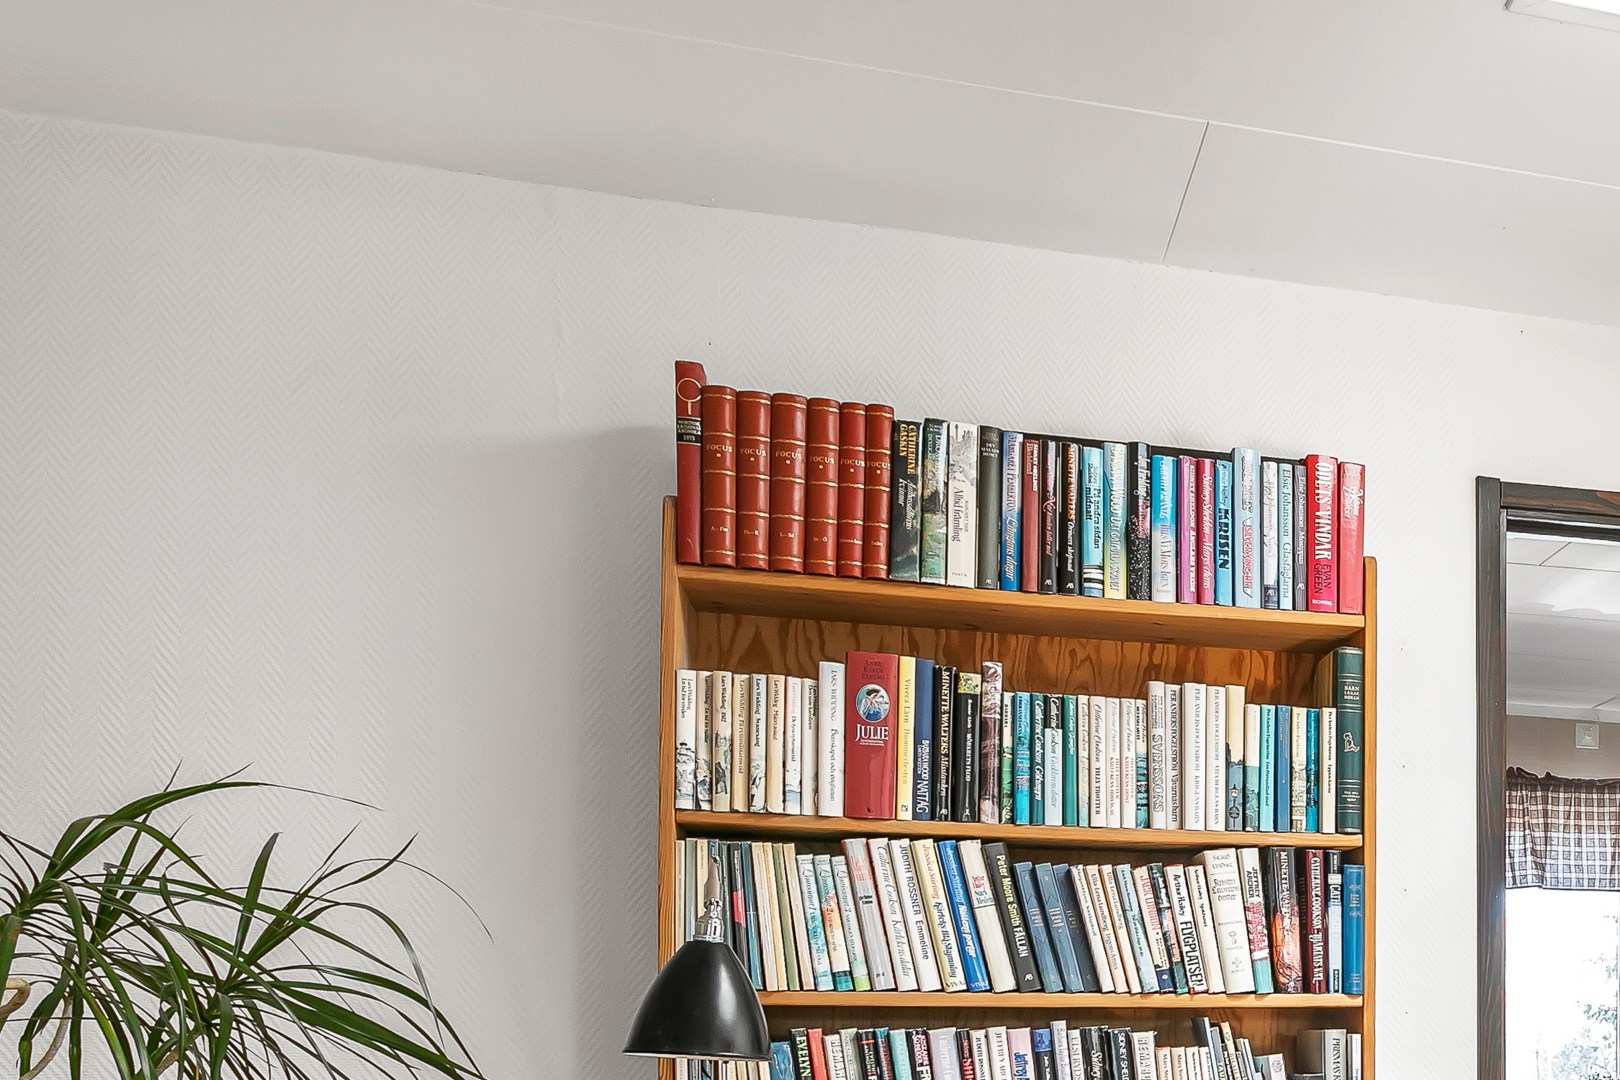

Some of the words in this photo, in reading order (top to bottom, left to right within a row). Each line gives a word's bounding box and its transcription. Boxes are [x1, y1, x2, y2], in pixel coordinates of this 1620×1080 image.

[706, 444, 733, 453] FOCUS
[740, 448, 766, 457] FOCUS
[775, 450, 802, 460] FOCUS
[907, 425, 916, 474] CATHERINE
[840, 459, 866, 468] FOCUS
[867, 460, 891, 470] FOCUS
[1110, 488, 1124, 513] WOOD
[1201, 475, 1212, 500] Sidney
[1202, 501, 1212, 534] Sheldon
[1281, 491, 1291, 537] Johansson
[1219, 508, 1229, 569] KRISEN
[1314, 510, 1333, 560] VINDAR
[1005, 556, 1015, 581] dagar
[1203, 566, 1211, 589] chans
[1314, 563, 1323, 594] GREEN
[1323, 563, 1331, 589] EVAN
[941, 671, 950, 712] MINETTE
[856, 723, 889, 741] JULIE
[941, 714, 950, 754] WALTERS
[1152, 734, 1163, 812] SVENSSONS
[899, 845, 911, 874] JUDITH
[906, 877, 921, 915] ROSSNER
[996, 855, 1008, 877] Peter
[1281, 852, 1290, 890] MINETTE
[1311, 857, 1321, 896] CATHERINE
[1001, 878, 1014, 902] Moore
[1246, 870, 1254, 898] ARCHER
[1252, 867, 1260, 898] JEFFREY
[1008, 904, 1021, 927] Smith
[1312, 897, 1322, 929] COOKSON
[915, 920, 929, 960] Emmeline
[1013, 927, 1029, 958] FÄLLAN
[1180, 921, 1204, 987] FLYGPLATSEN
[796, 1036, 813, 1080] EVELYN
[1118, 1032, 1128, 1059] SIDNEY
[1014, 1052, 1029, 1077] Jeffrey
[1090, 1051, 1104, 1078] Sidney
